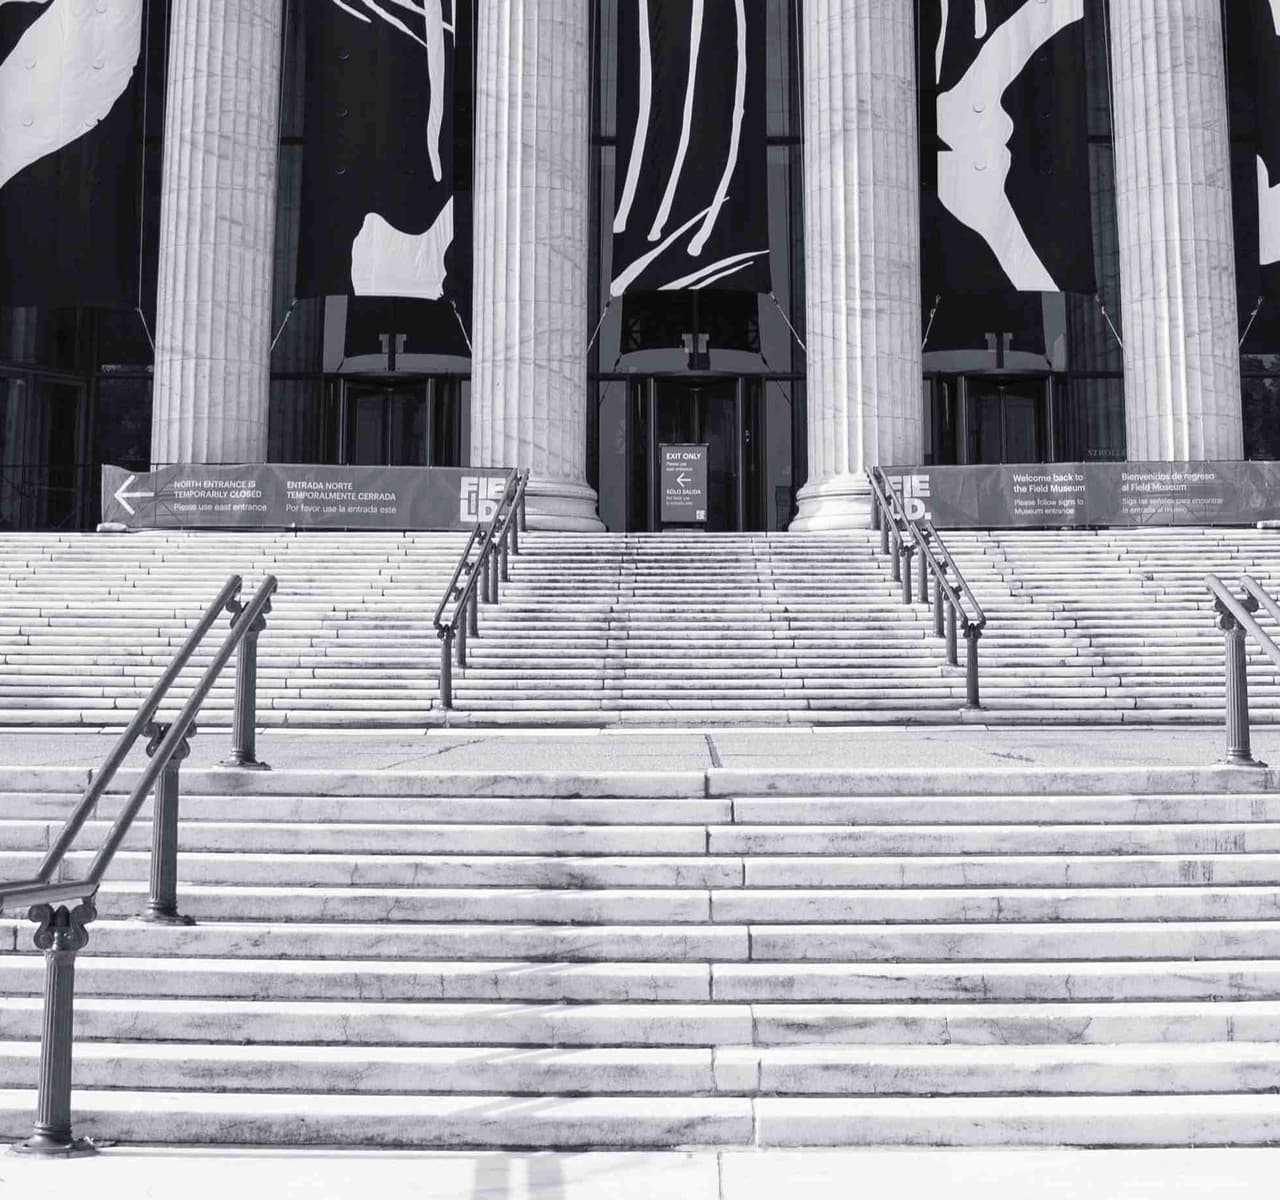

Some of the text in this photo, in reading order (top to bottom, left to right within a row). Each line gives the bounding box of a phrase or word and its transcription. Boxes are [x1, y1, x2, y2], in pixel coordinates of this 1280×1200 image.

[666, 452, 702, 460] EXIT ONLY
[1013, 473, 1052, 482] Welcome
[1053, 473, 1074, 482] back
[1121, 472, 1215, 482] Bienvenidos de regreso
[174, 480, 256, 488] NORTH ENTRANCE IS
[286, 480, 353, 490] ENTRADA NORTE
[1013, 484, 1086, 493] the Field Museum
[1121, 483, 1187, 492] al Field Museum
[174, 490, 262, 498] TEMPORARILY CLOSED
[287, 491, 396, 501] TEMPORALMENTE CERRADA
[174, 503, 197, 511] Please
[286, 503, 397, 514] Por favor use la entrada este
